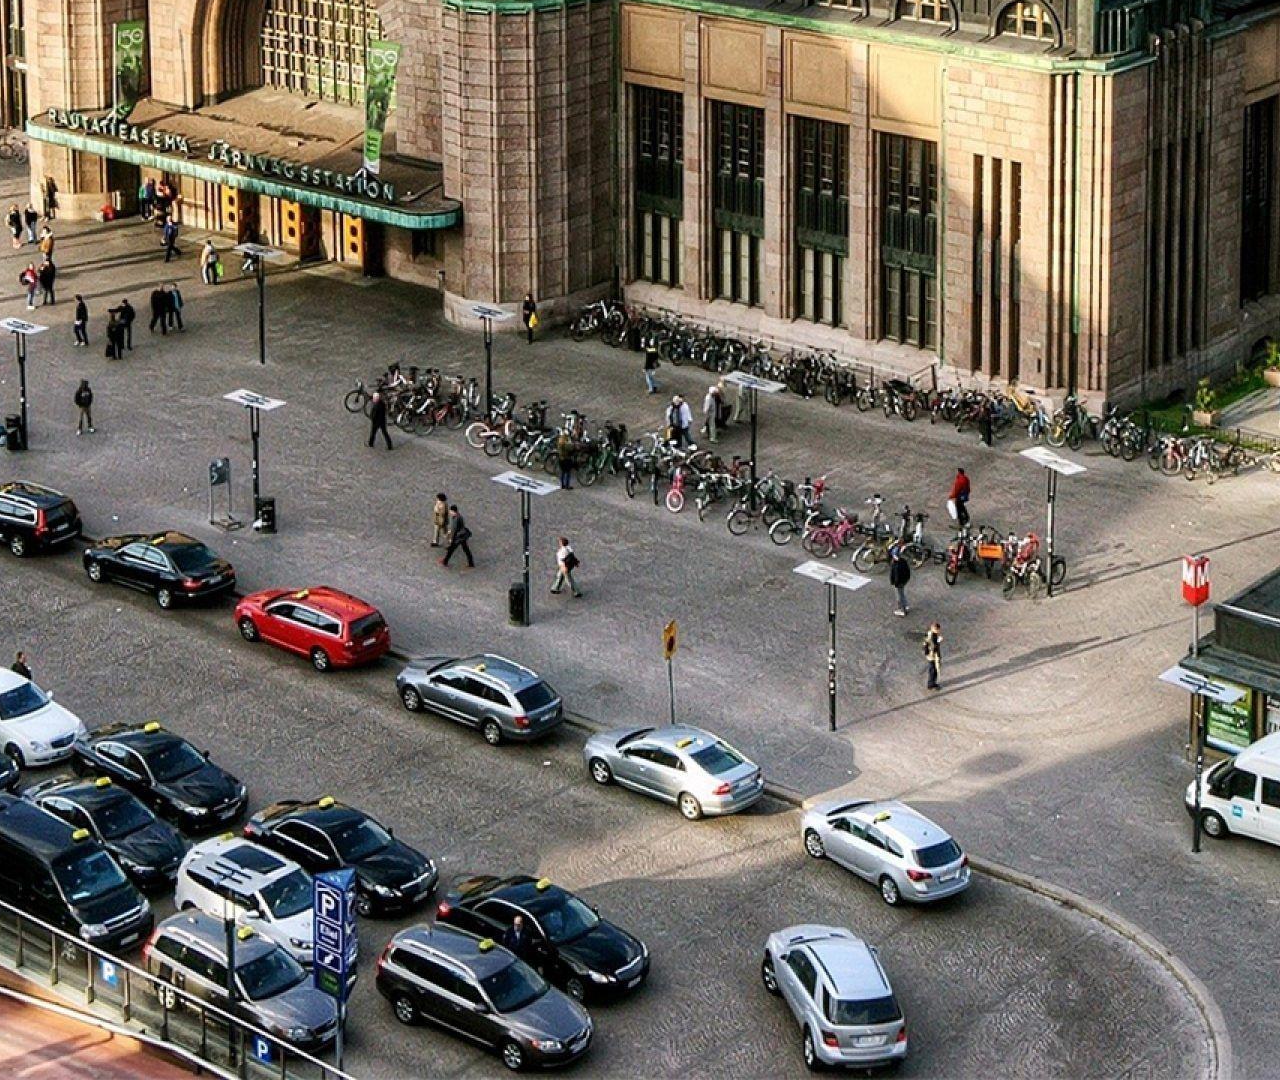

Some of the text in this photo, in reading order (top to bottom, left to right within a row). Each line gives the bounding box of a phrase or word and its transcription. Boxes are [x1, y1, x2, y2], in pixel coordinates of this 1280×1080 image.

[321, 894, 335, 918] P
[103, 962, 115, 982] P
[257, 1040, 269, 1060] P
